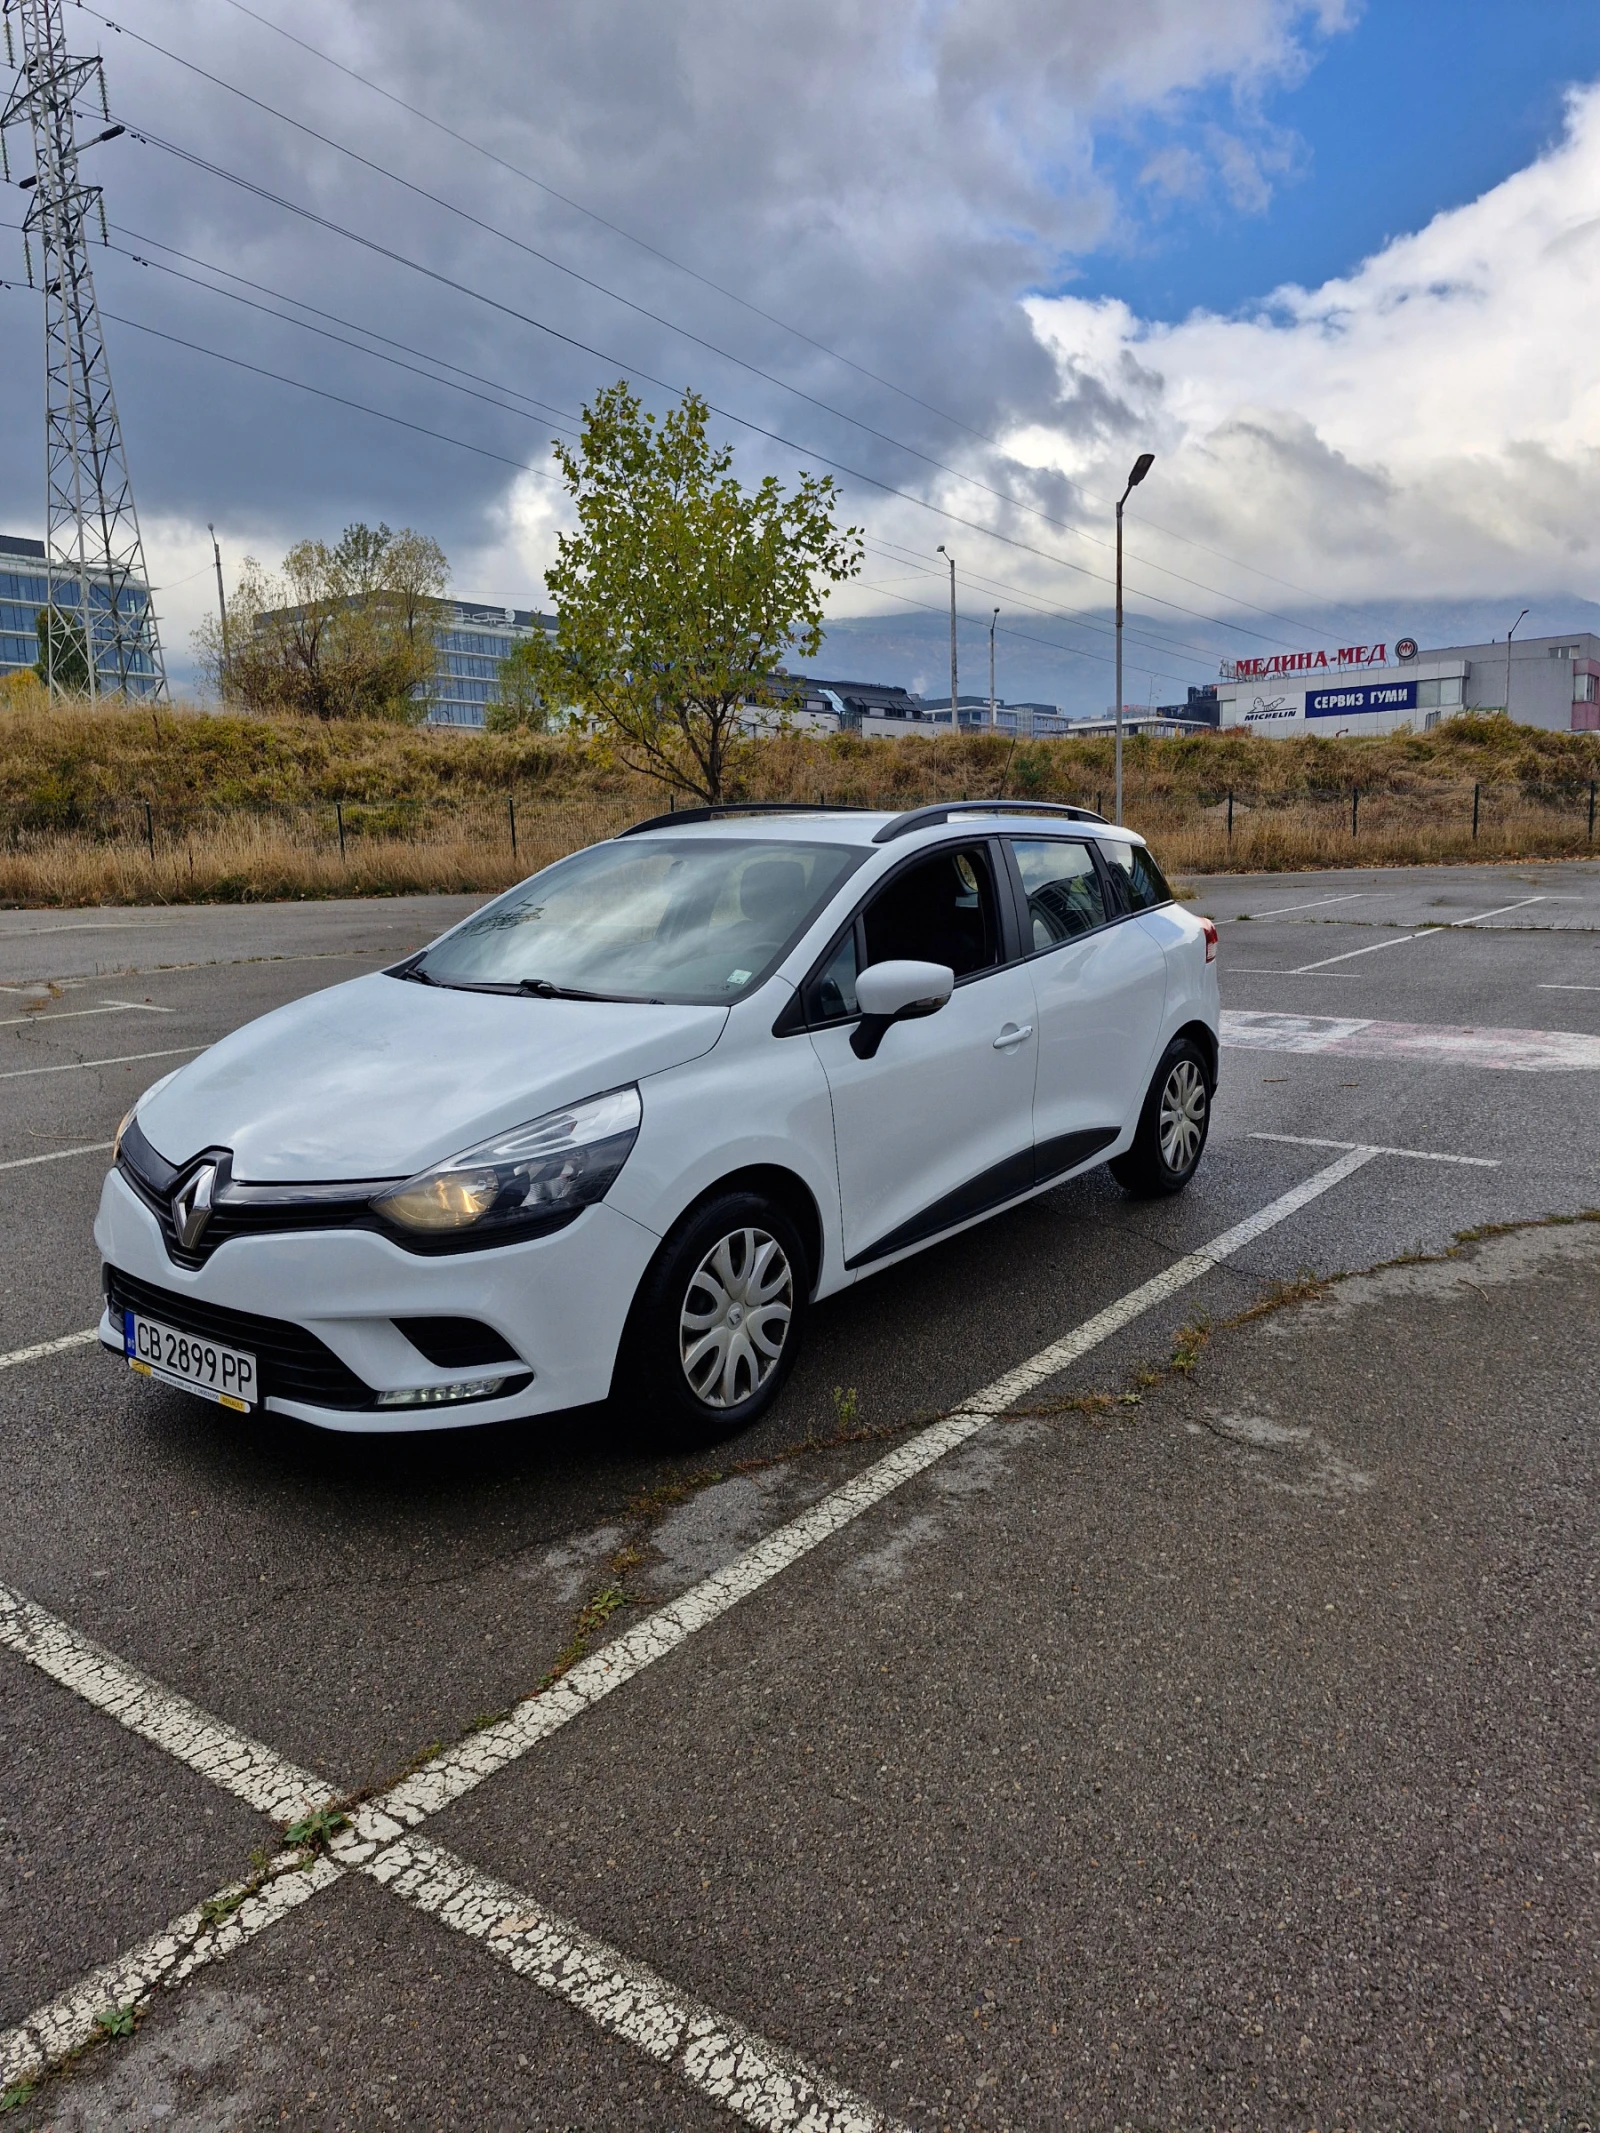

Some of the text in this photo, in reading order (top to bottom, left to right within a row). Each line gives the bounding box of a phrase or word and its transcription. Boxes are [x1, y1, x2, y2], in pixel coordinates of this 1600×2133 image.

[1236, 643, 1387, 677] МЕДИНА-МЕД
[1314, 688, 1408, 709] СЕРВИЗ ГУМИ
[1244, 710, 1297, 721] MICHELIN
